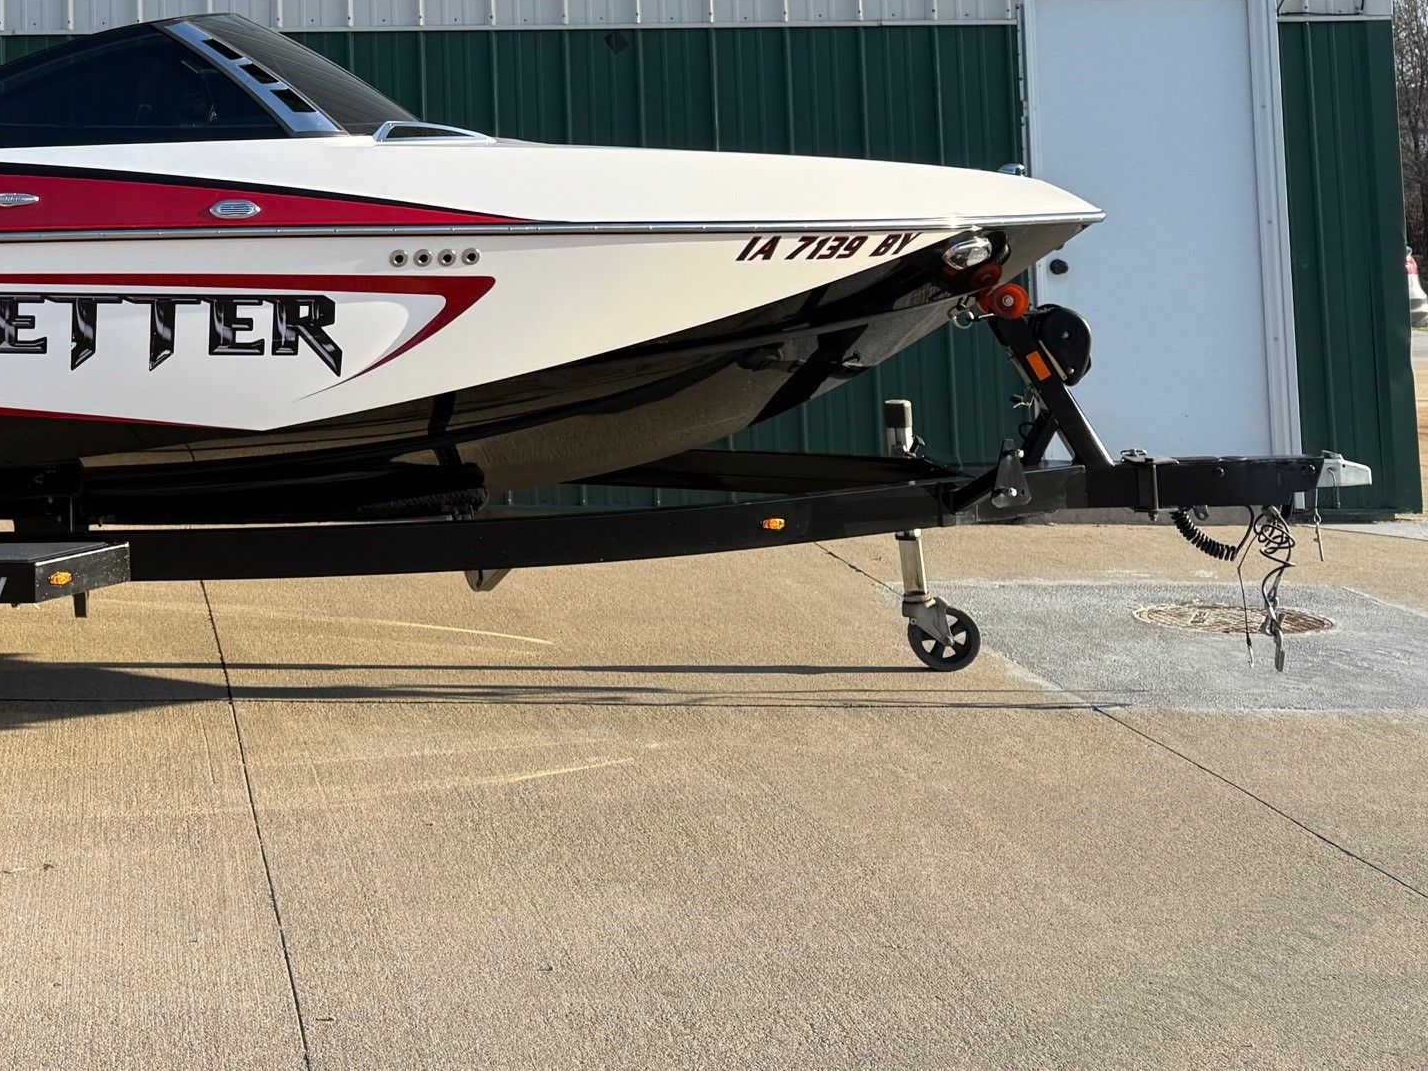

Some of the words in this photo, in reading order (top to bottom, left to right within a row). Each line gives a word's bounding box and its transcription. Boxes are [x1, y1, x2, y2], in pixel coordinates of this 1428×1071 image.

[736, 235, 781, 261] IA
[785, 235, 869, 261] 7139
[869, 232, 924, 257] BY
